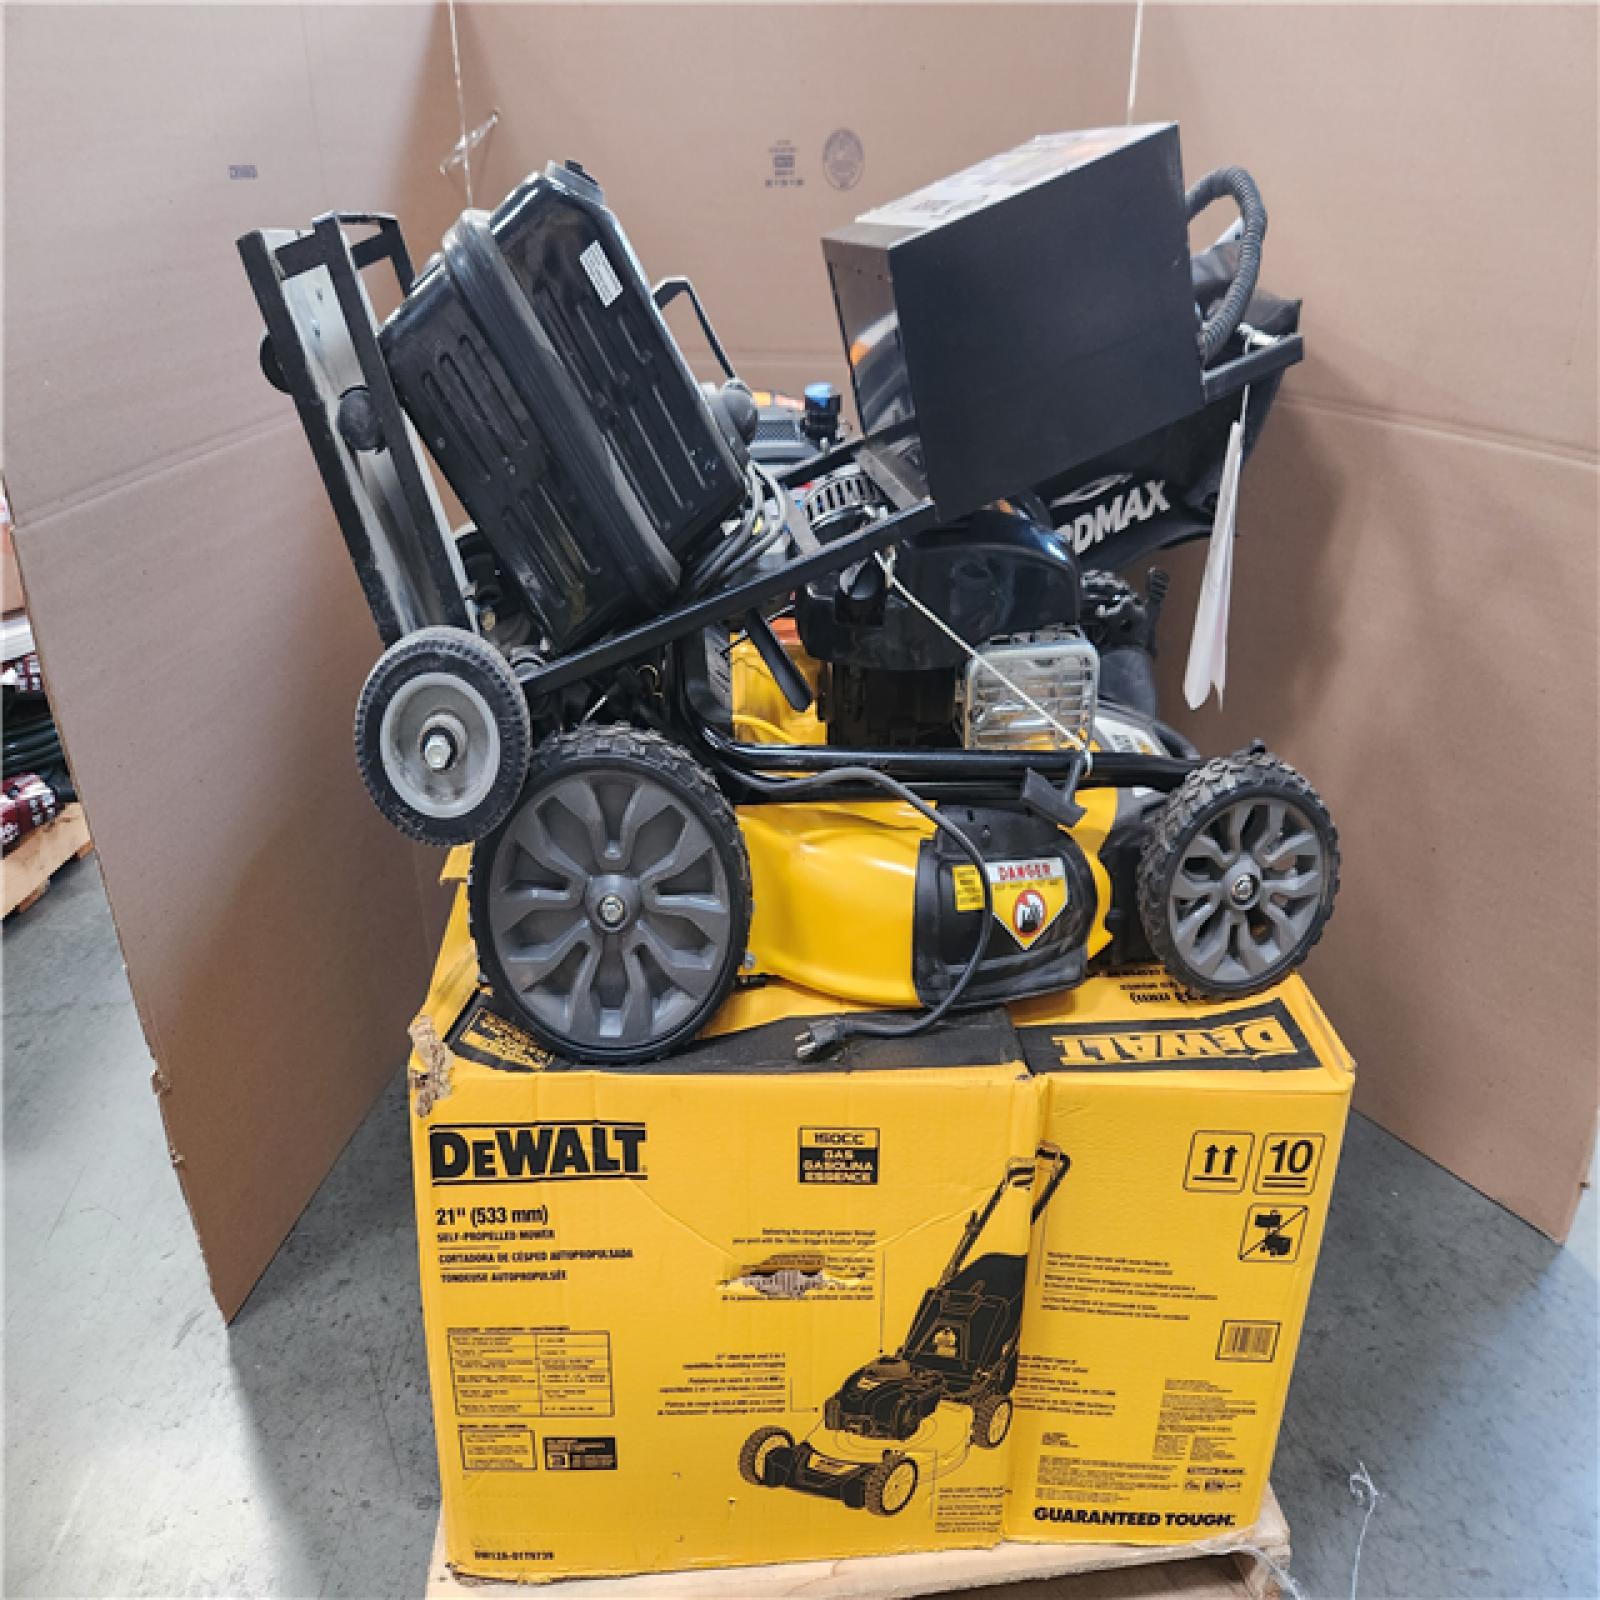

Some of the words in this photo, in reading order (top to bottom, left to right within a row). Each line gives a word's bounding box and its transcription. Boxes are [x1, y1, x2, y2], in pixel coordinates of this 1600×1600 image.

[824, 1149, 854, 1159] GAS
[1269, 1139, 1314, 1174] 10
[803, 1159, 873, 1171] GASOLINA
[435, 1207, 466, 1226] 21"
[470, 1206, 508, 1228] (533
[511, 1204, 549, 1226] mm)
[437, 1230, 516, 1243] SELF-PROPELLED
[519, 1229, 556, 1241] MOWER
[1034, 1507, 1161, 1527] GUARANTEED
